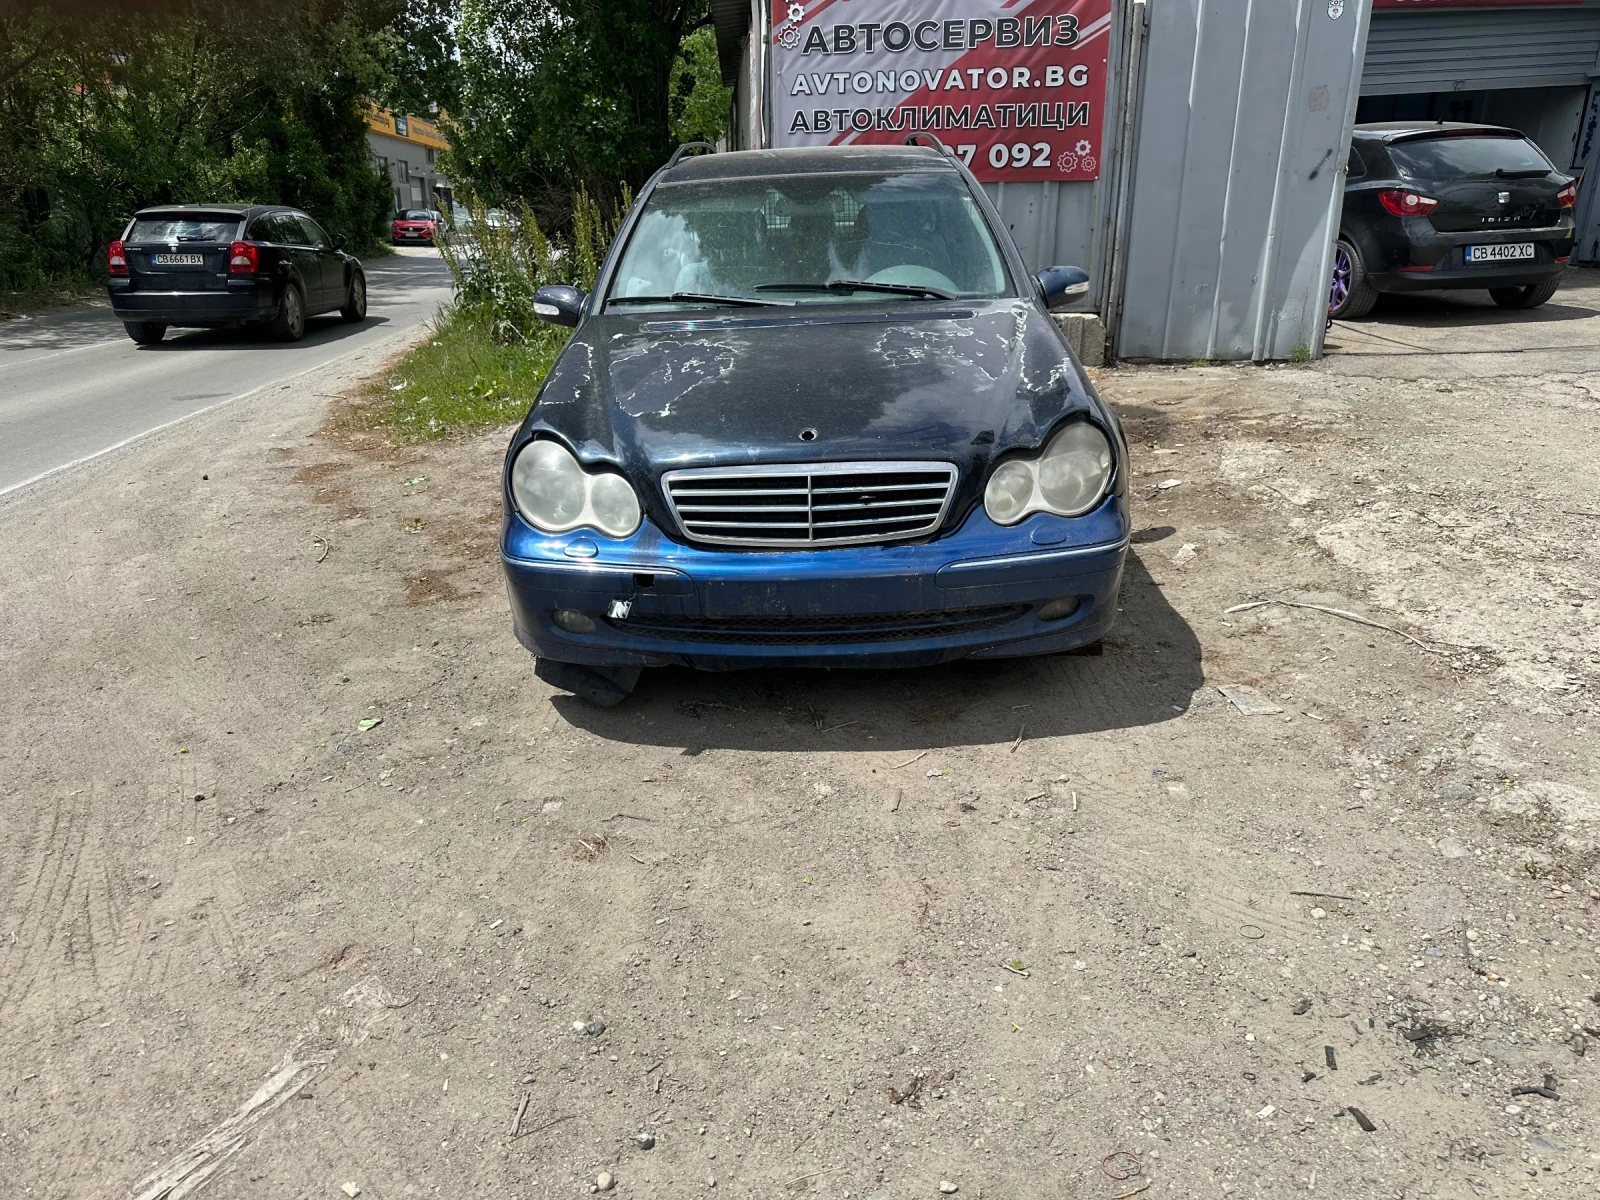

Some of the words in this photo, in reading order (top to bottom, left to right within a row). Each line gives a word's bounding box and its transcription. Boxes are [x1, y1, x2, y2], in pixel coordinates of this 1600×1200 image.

[801, 14, 1080, 56] АВТОСЕРВИЗ
[790, 64, 1090, 96] AVTONOVATOR.BG
[788, 102, 1090, 134] АВТОКЛИМАТИЦИ
[988, 142, 1051, 168] 092
[169, 255, 189, 263] 6661
[1490, 246, 1516, 258] 4402
